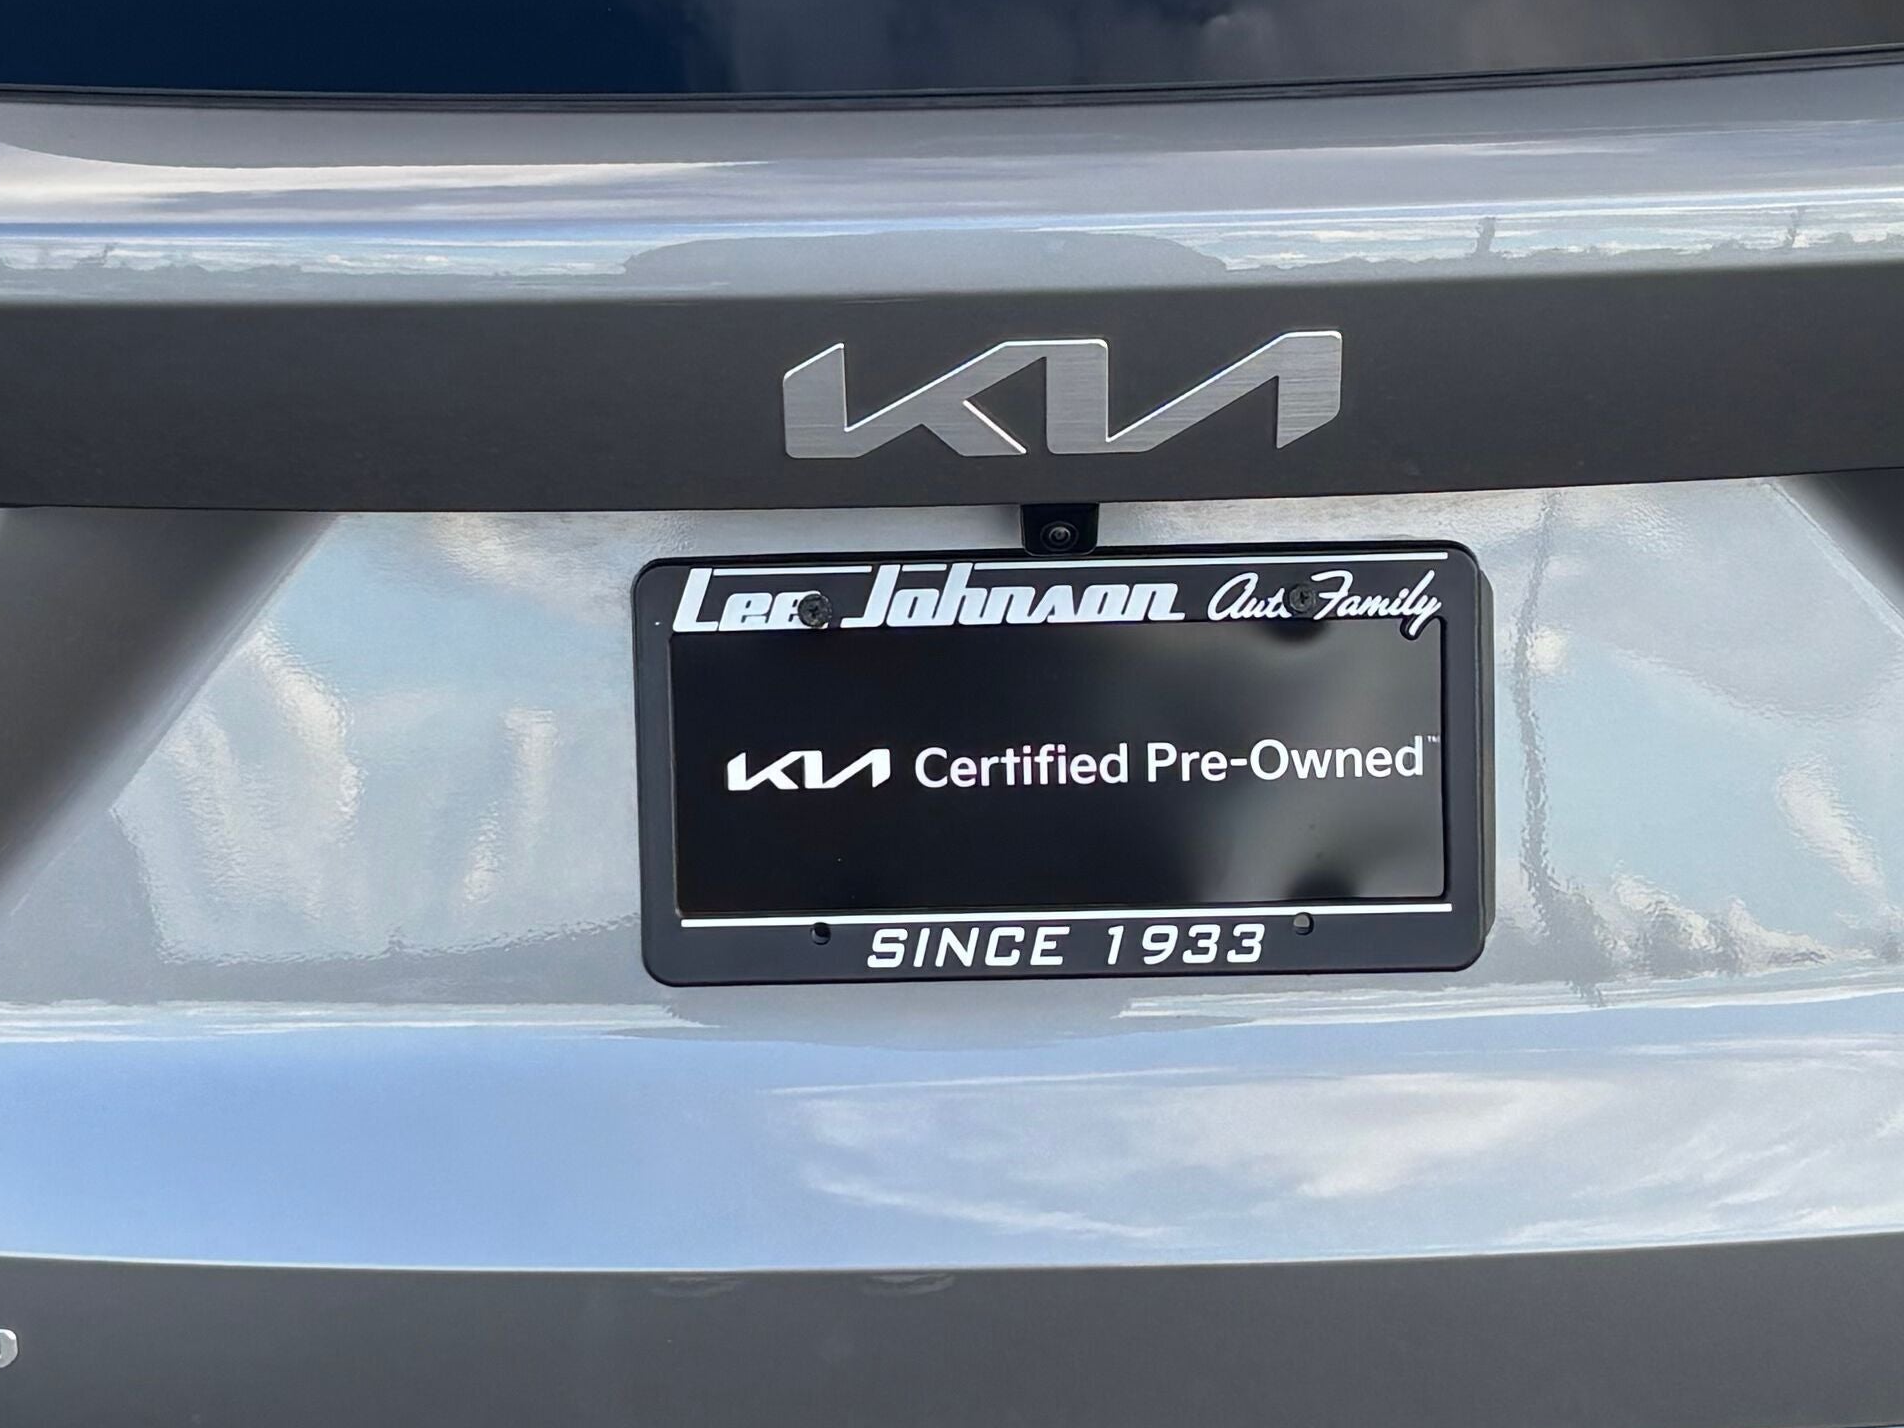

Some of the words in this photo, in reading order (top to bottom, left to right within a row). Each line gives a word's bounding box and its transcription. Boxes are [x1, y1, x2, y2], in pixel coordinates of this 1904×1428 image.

[783, 331, 1342, 458] KIA
[840, 563, 1185, 628] Johnson
[1207, 572, 1294, 621] Aut
[1310, 569, 1442, 637] Family
[727, 749, 892, 791] KIA
[914, 743, 1130, 788] Certified
[867, 925, 1071, 969] SINCE
[1107, 922, 1267, 966] 1933
